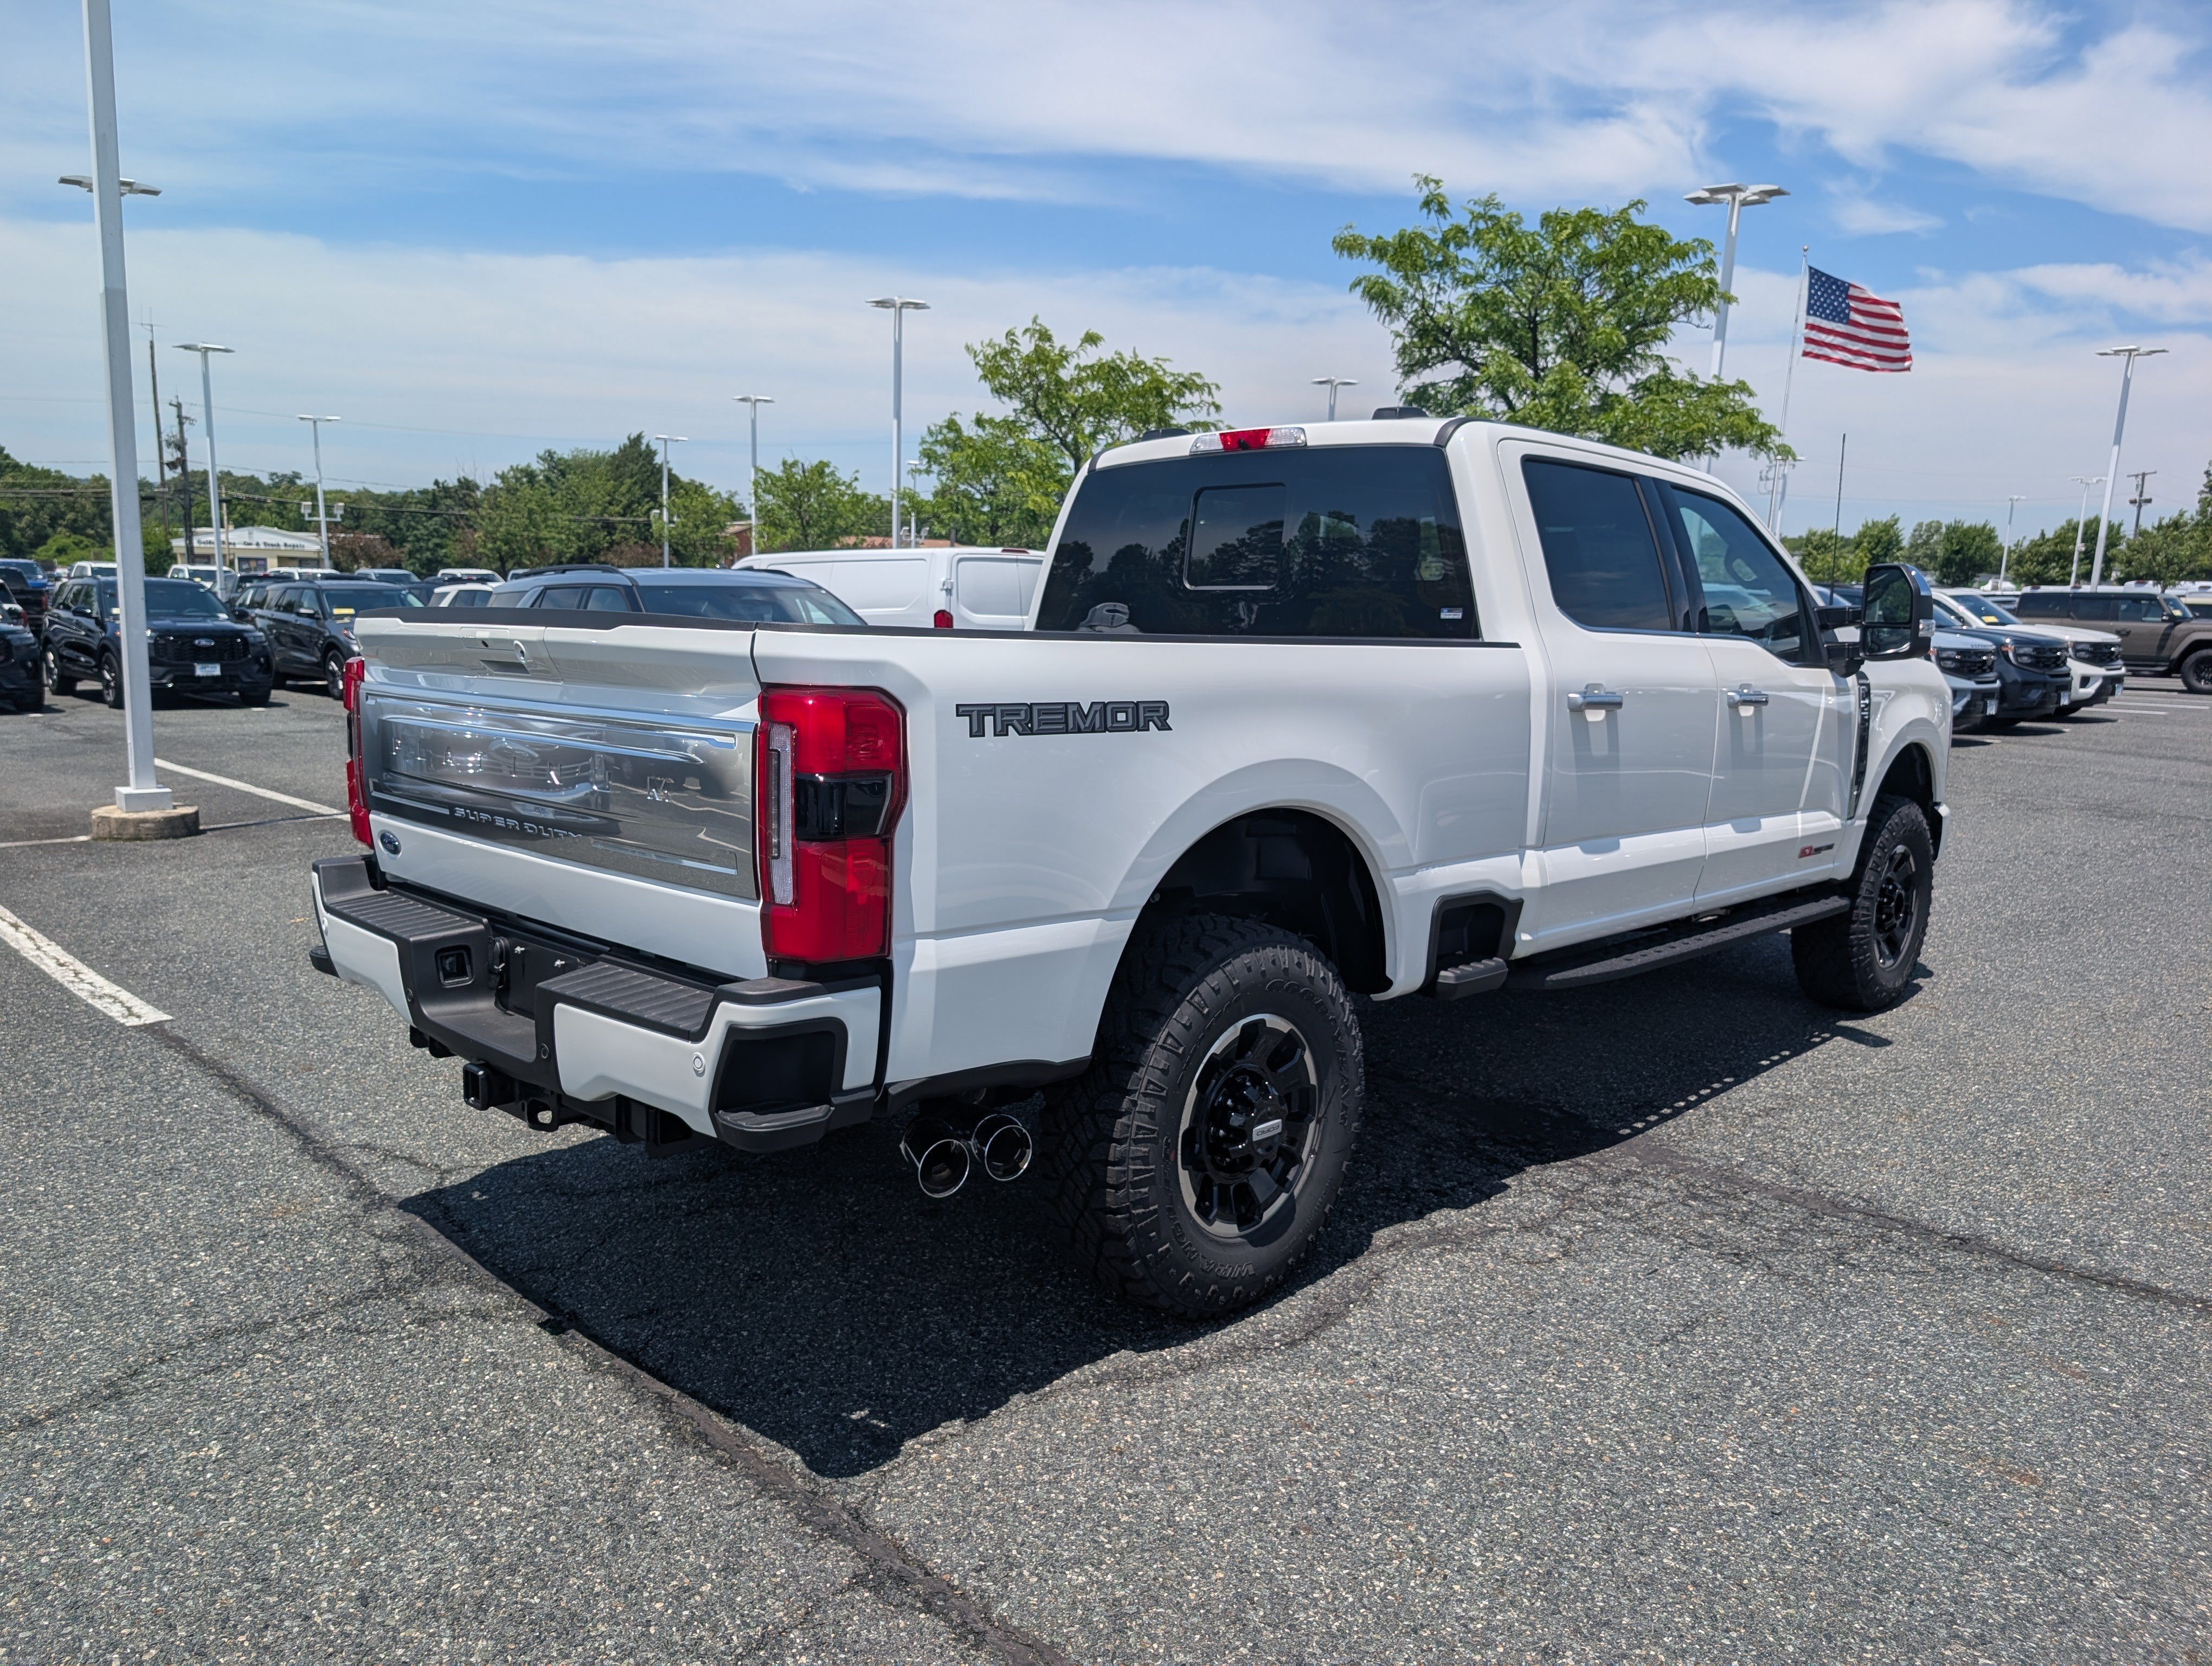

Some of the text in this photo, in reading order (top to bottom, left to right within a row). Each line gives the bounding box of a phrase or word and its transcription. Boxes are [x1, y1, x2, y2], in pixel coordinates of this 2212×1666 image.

[956, 700, 1173, 738] TREMOR
[454, 807, 582, 841] SUPER DUTY
[1256, 1125, 1279, 1136] FORD
